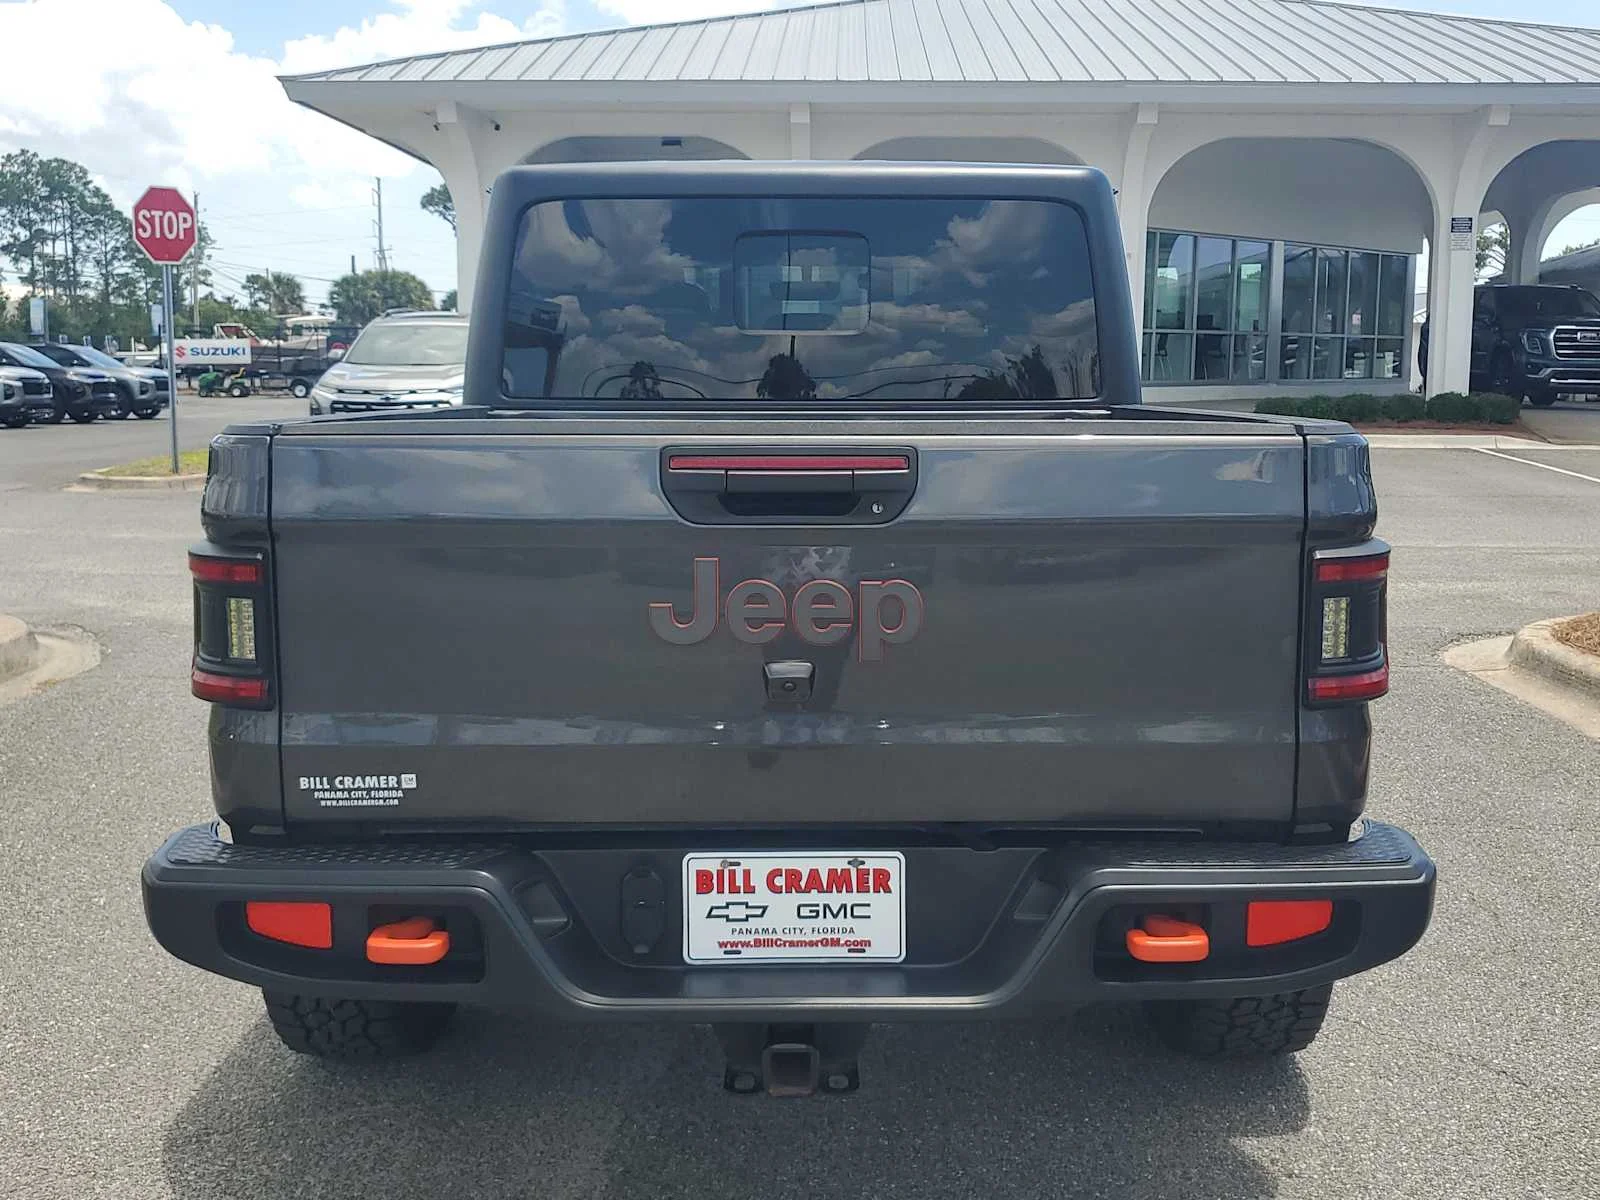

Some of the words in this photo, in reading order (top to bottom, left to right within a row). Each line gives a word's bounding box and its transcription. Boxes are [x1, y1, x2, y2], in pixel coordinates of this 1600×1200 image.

[138, 209, 192, 240] STOP
[190, 346, 246, 356] SUZUKI
[649, 557, 923, 662] Jeep
[300, 776, 331, 789] BILL
[334, 775, 398, 788] CRAMER
[314, 791, 349, 799] PANAMA
[351, 790, 369, 799] CITY,
[371, 790, 403, 798] FLORIDA
[695, 868, 756, 895] BILL
[766, 867, 892, 894] CRAMER
[796, 903, 872, 920] GMC
[731, 927, 777, 936] PANAMA
[782, 927, 808, 936] CITY,
[811, 926, 856, 935] FLORIDA
[717, 937, 872, 949] www.BillCramerGM.com
